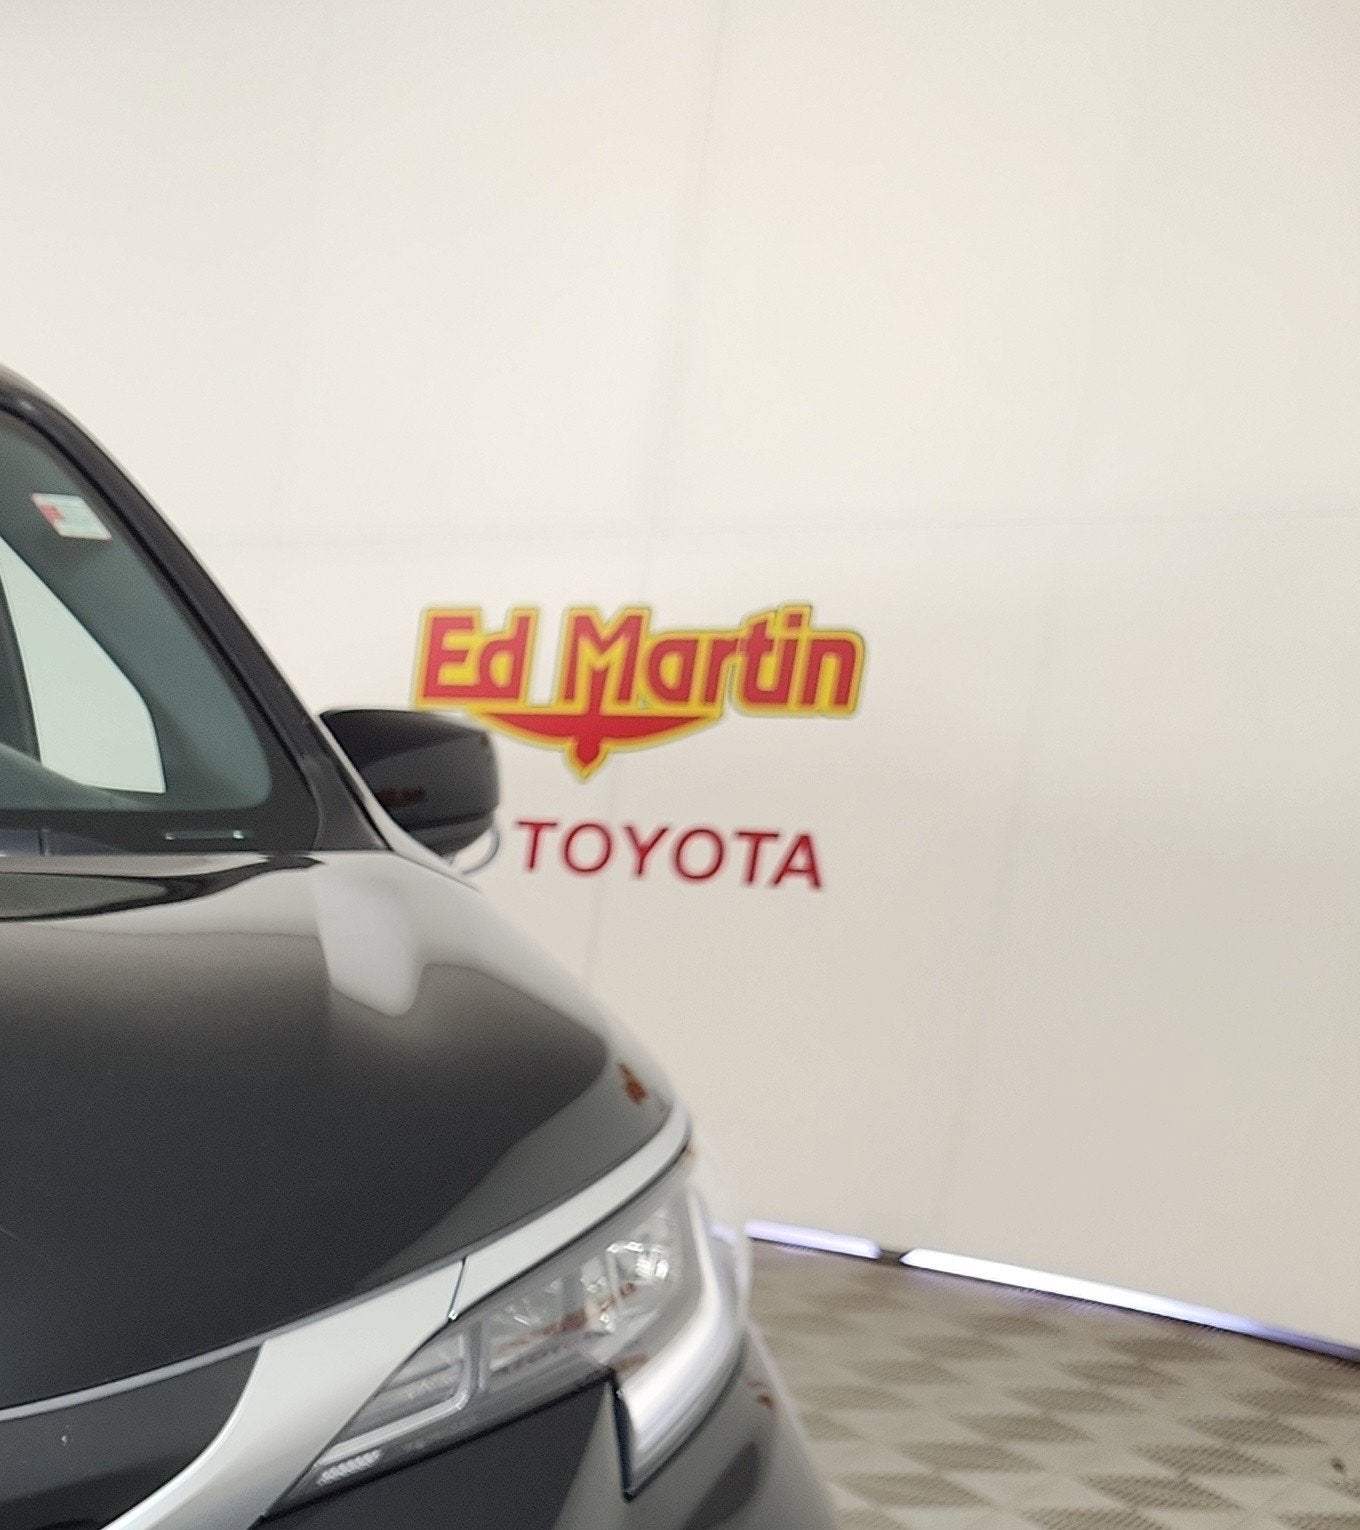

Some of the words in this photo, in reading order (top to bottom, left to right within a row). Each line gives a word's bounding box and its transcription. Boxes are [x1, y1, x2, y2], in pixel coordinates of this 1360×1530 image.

[420, 612, 534, 699] Ed
[562, 610, 858, 709] Martin
[517, 820, 824, 890] TOYOTA
